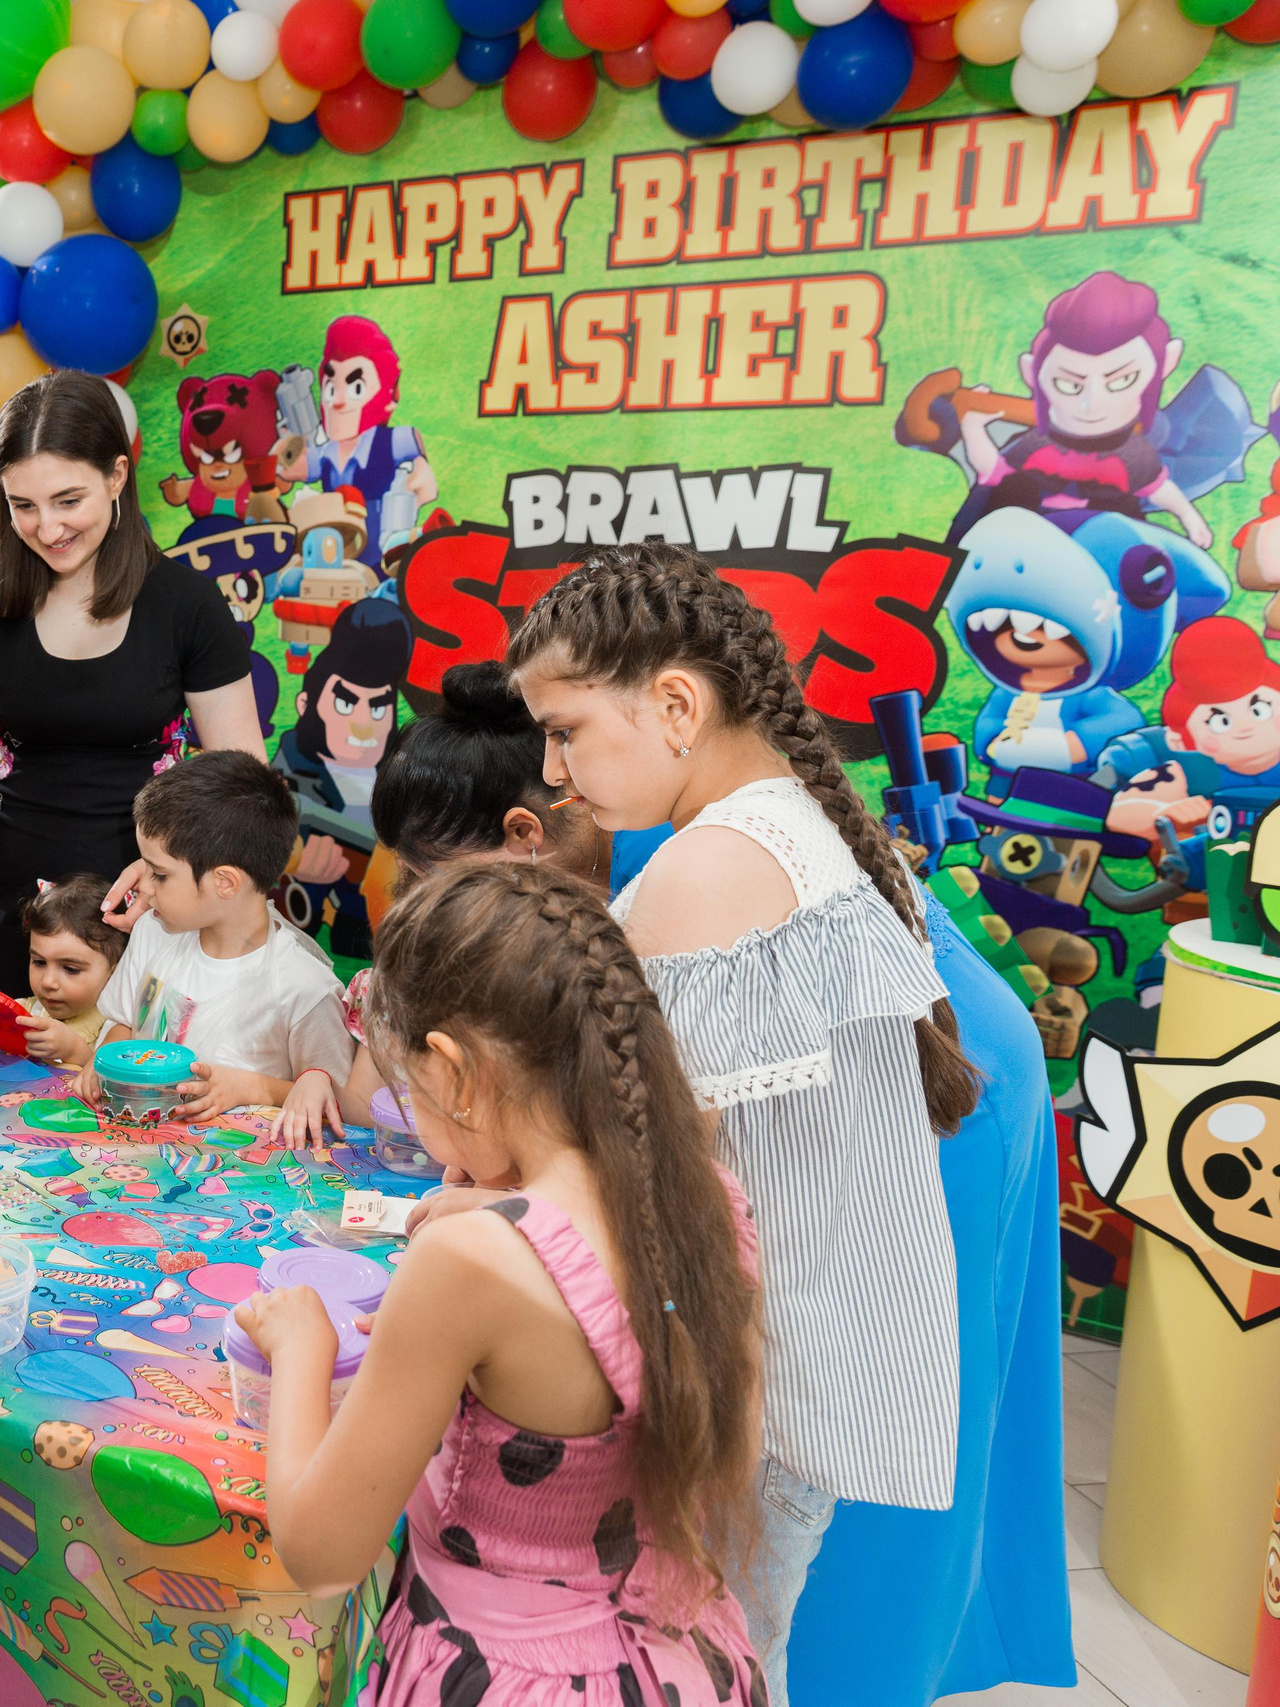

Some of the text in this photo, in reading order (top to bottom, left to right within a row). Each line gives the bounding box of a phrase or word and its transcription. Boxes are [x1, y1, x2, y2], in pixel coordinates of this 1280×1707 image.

[282, 83, 1238, 293] HAPPY BIRTHDAY
[479, 271, 887, 416] ASHER
[508, 469, 840, 552] BRAWL
